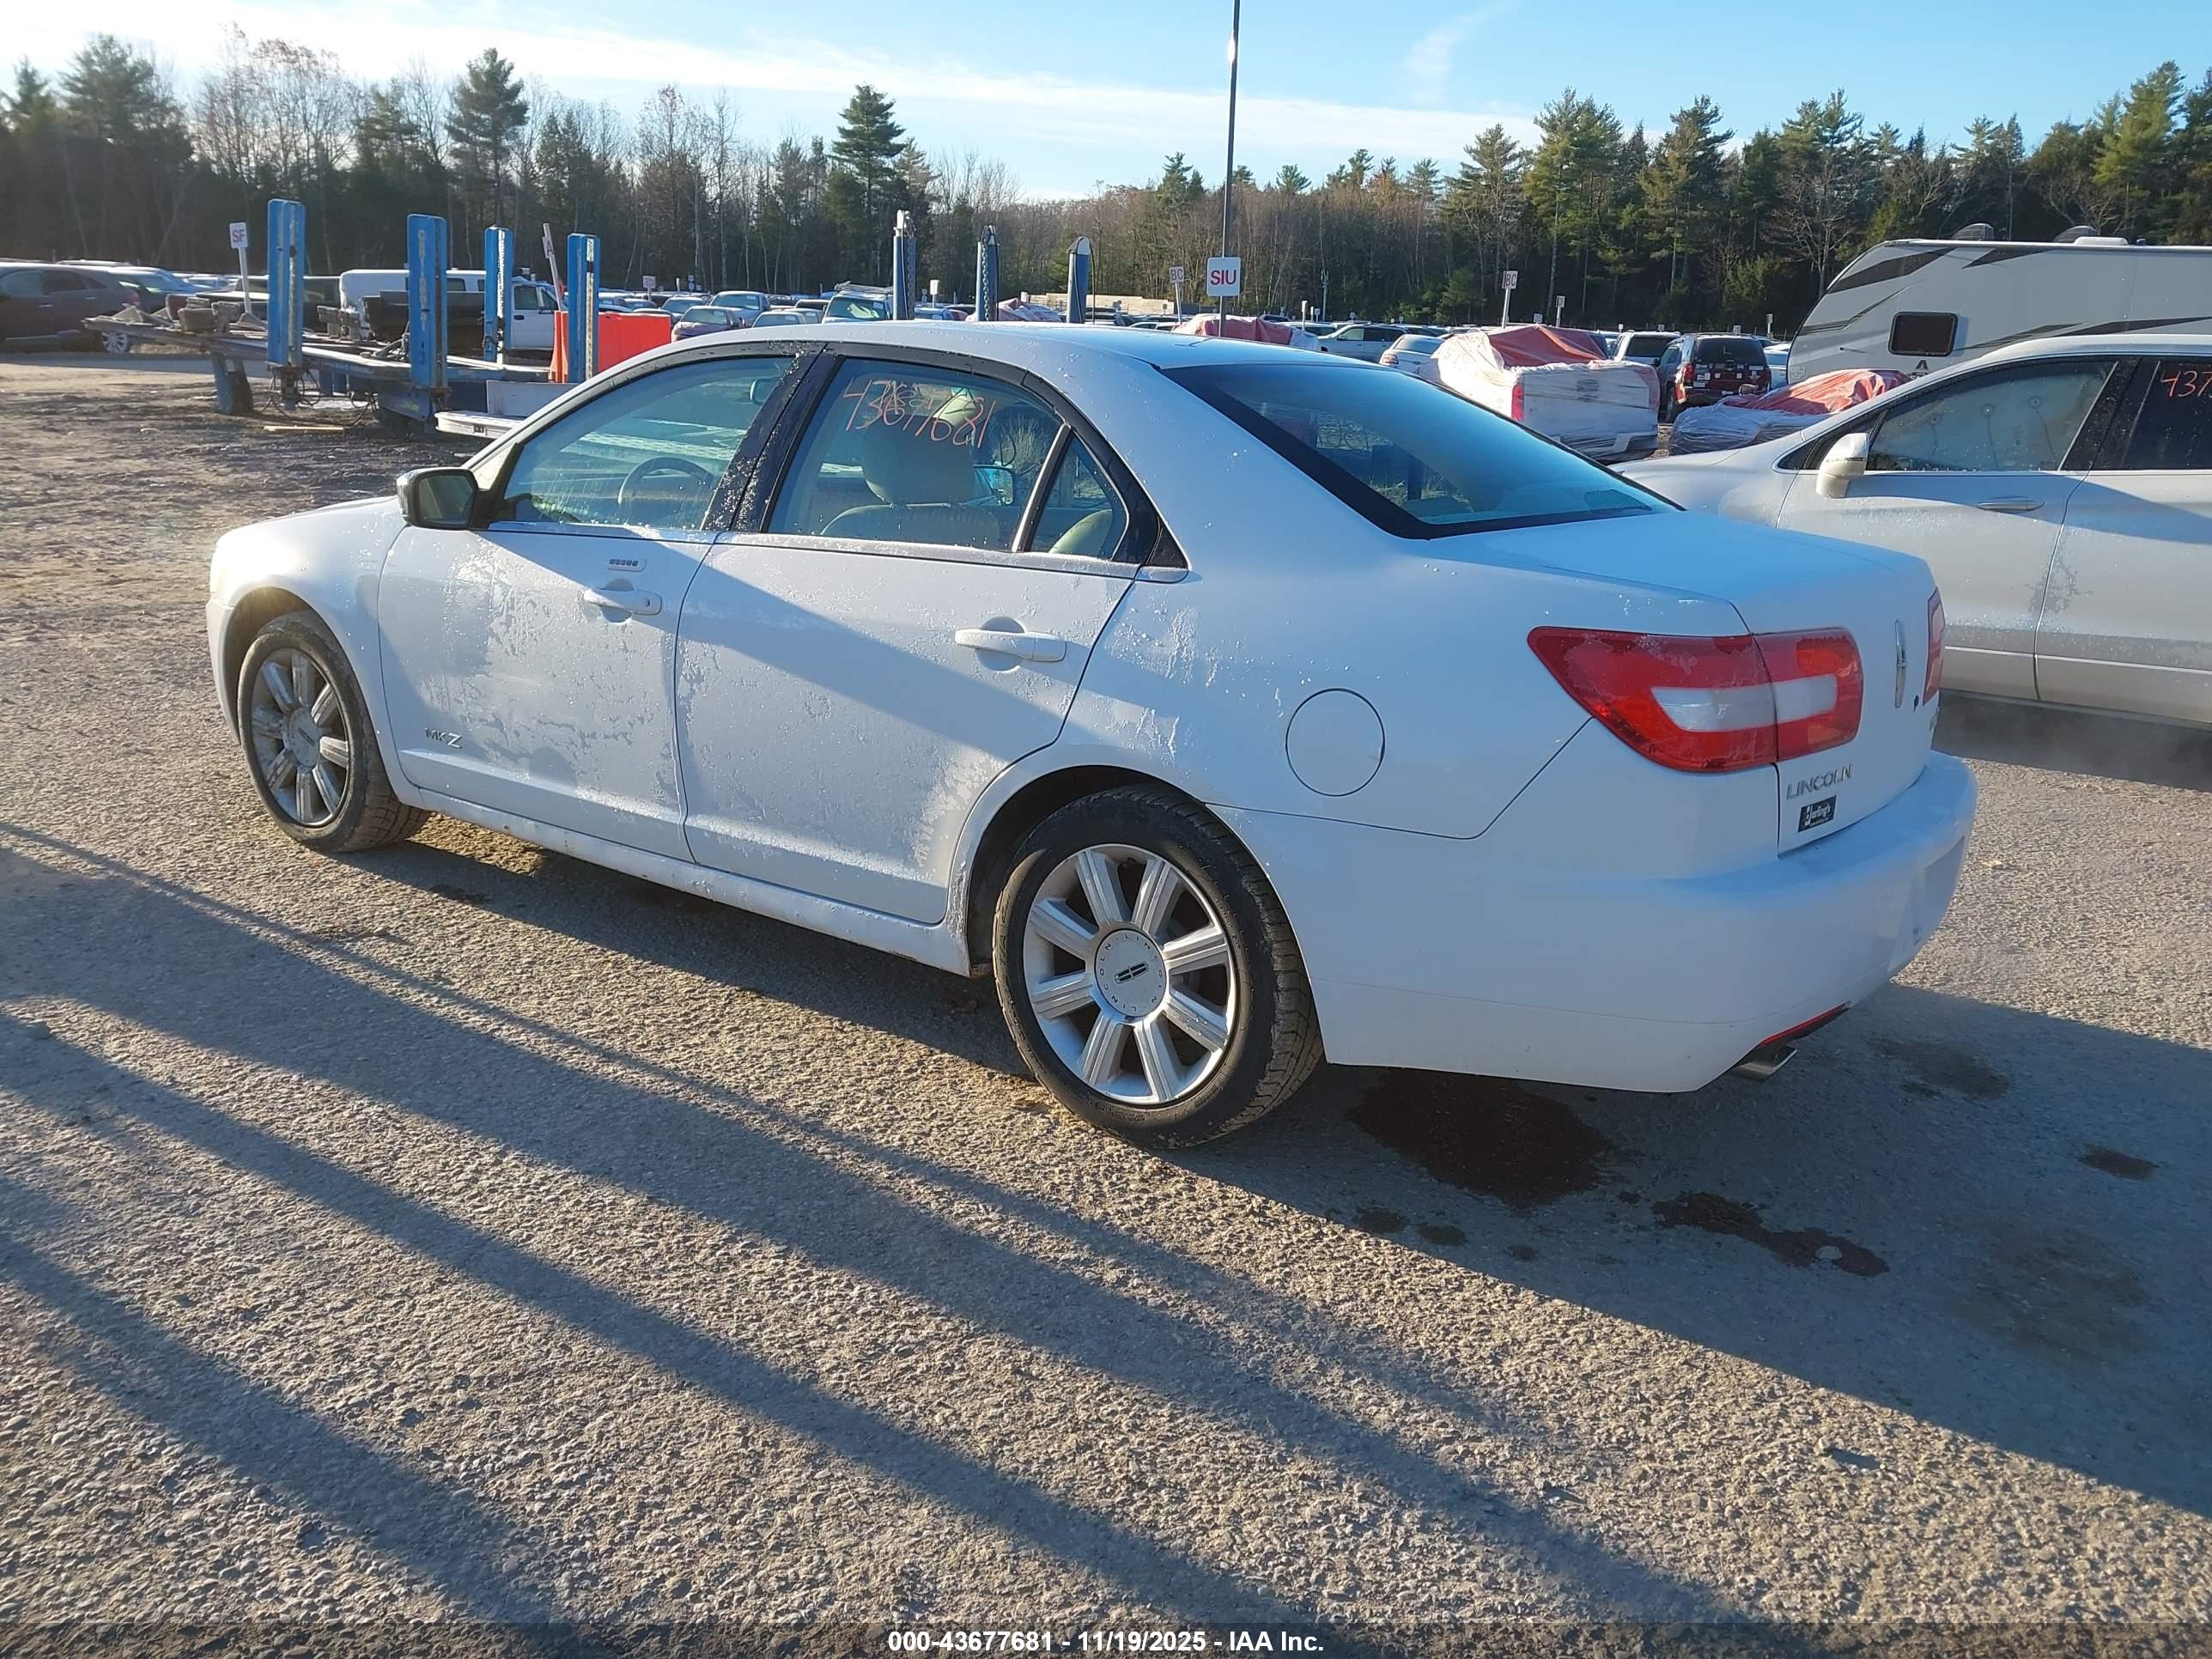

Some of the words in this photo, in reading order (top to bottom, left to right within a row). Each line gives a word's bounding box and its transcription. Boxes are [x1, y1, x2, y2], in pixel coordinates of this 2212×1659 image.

[233, 228, 245, 242] SF
[1170, 269, 1183, 281] BC
[1210, 270, 1237, 286] SIU
[1505, 273, 1517, 287] BC
[1786, 763, 1852, 800] LINCOLN
